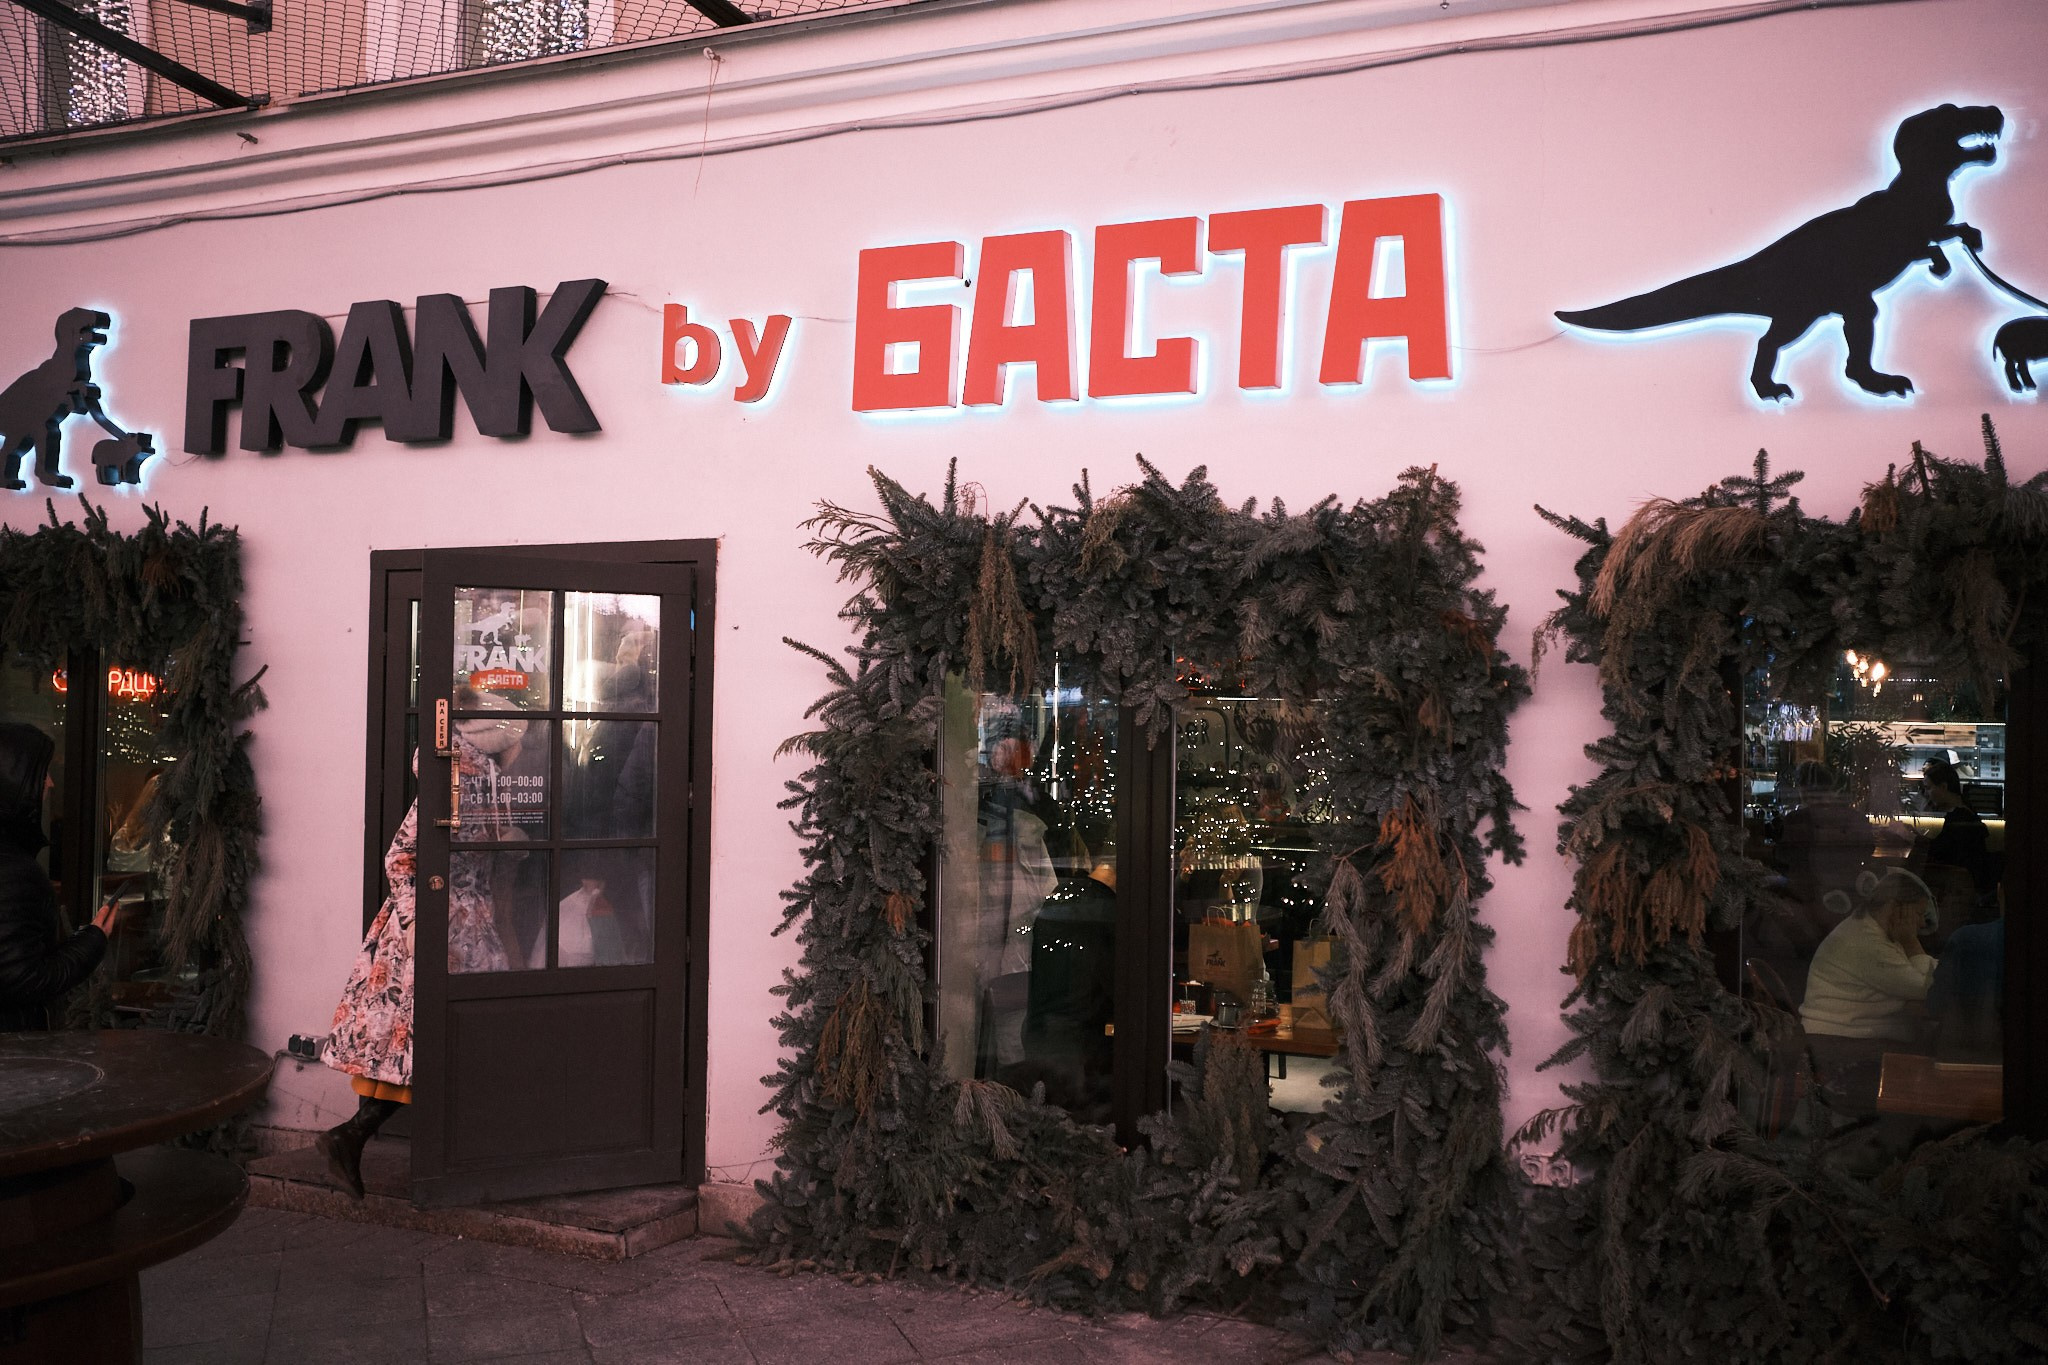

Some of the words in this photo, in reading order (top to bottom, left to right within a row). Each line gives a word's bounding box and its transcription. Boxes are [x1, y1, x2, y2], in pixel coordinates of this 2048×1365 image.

[184, 278, 608, 456] FRANK
[661, 303, 792, 403] by
[852, 193, 1454, 413] БАСТА
[453, 645, 548, 672] FRANK
[440, 701, 445, 715] НА
